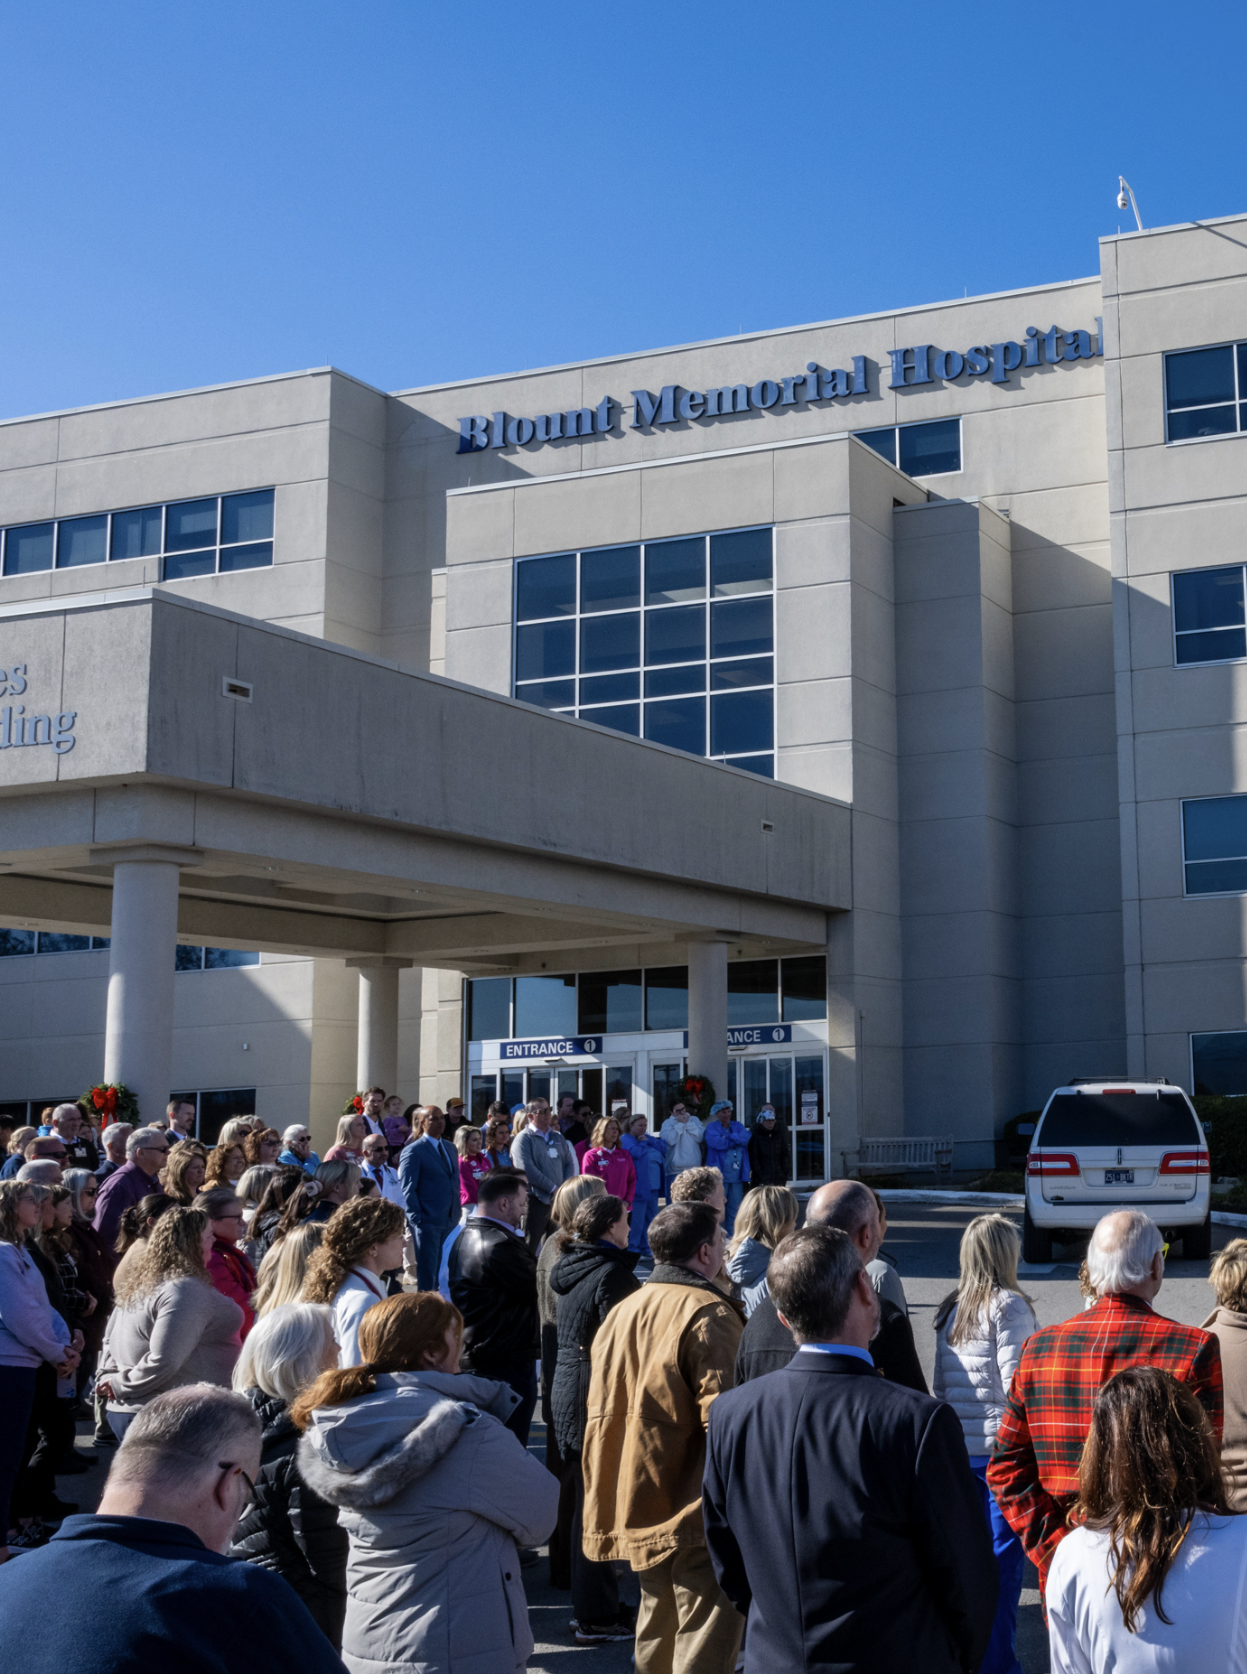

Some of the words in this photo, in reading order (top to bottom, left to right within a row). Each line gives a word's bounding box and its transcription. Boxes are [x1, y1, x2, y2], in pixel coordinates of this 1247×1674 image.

[456, 395, 614, 455] Blount
[629, 355, 871, 429] Memorial
[887, 316, 1103, 389] Hospital
[727, 1030, 761, 1043] ANCE
[506, 1041, 573, 1057] ENTRANCE
